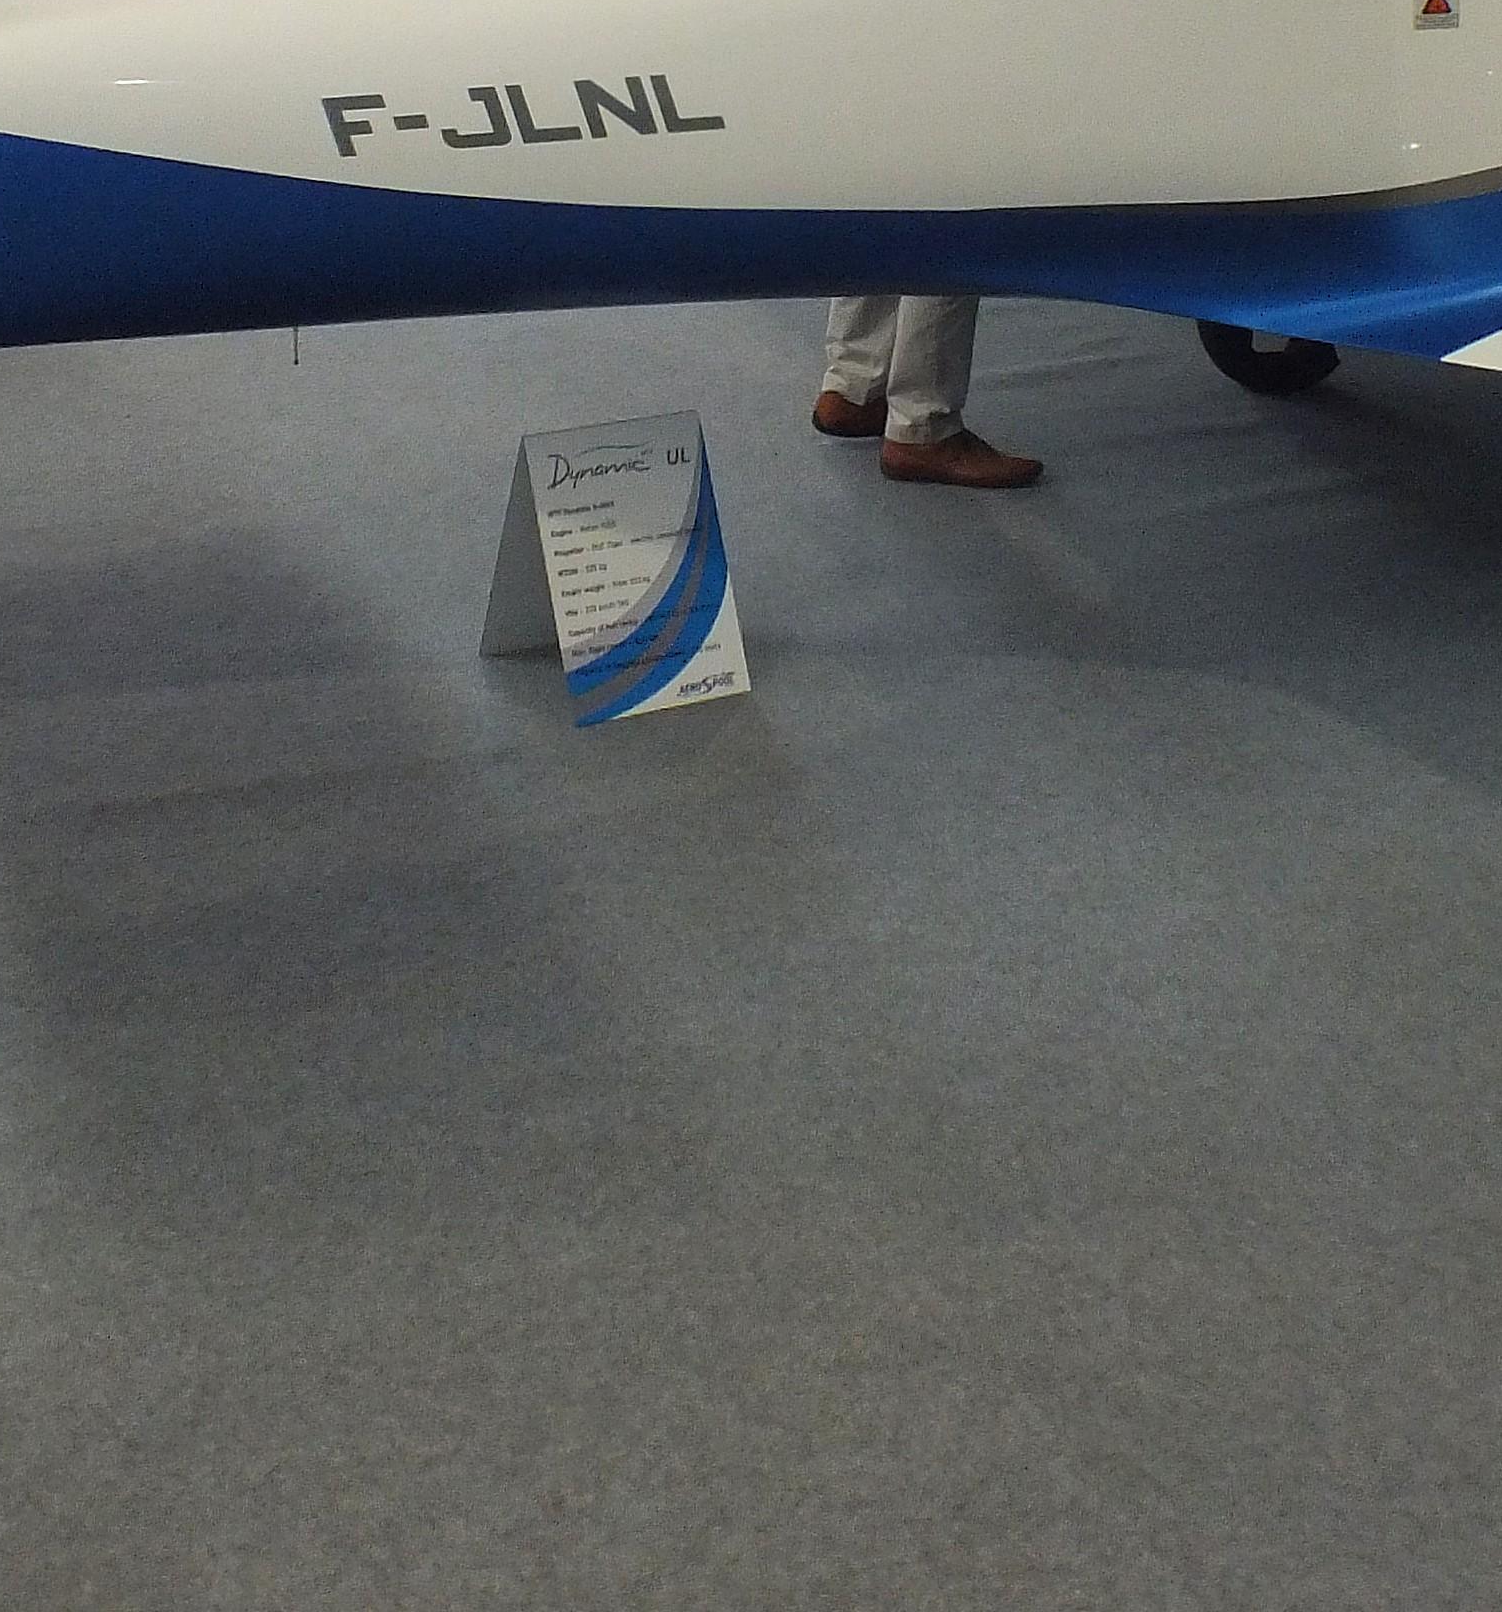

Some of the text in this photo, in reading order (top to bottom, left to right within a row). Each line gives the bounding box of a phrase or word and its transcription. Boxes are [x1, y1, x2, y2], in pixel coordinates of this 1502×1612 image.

[322, 74, 726, 158] F-JLNL
[547, 447, 691, 490] Dynamic UL
